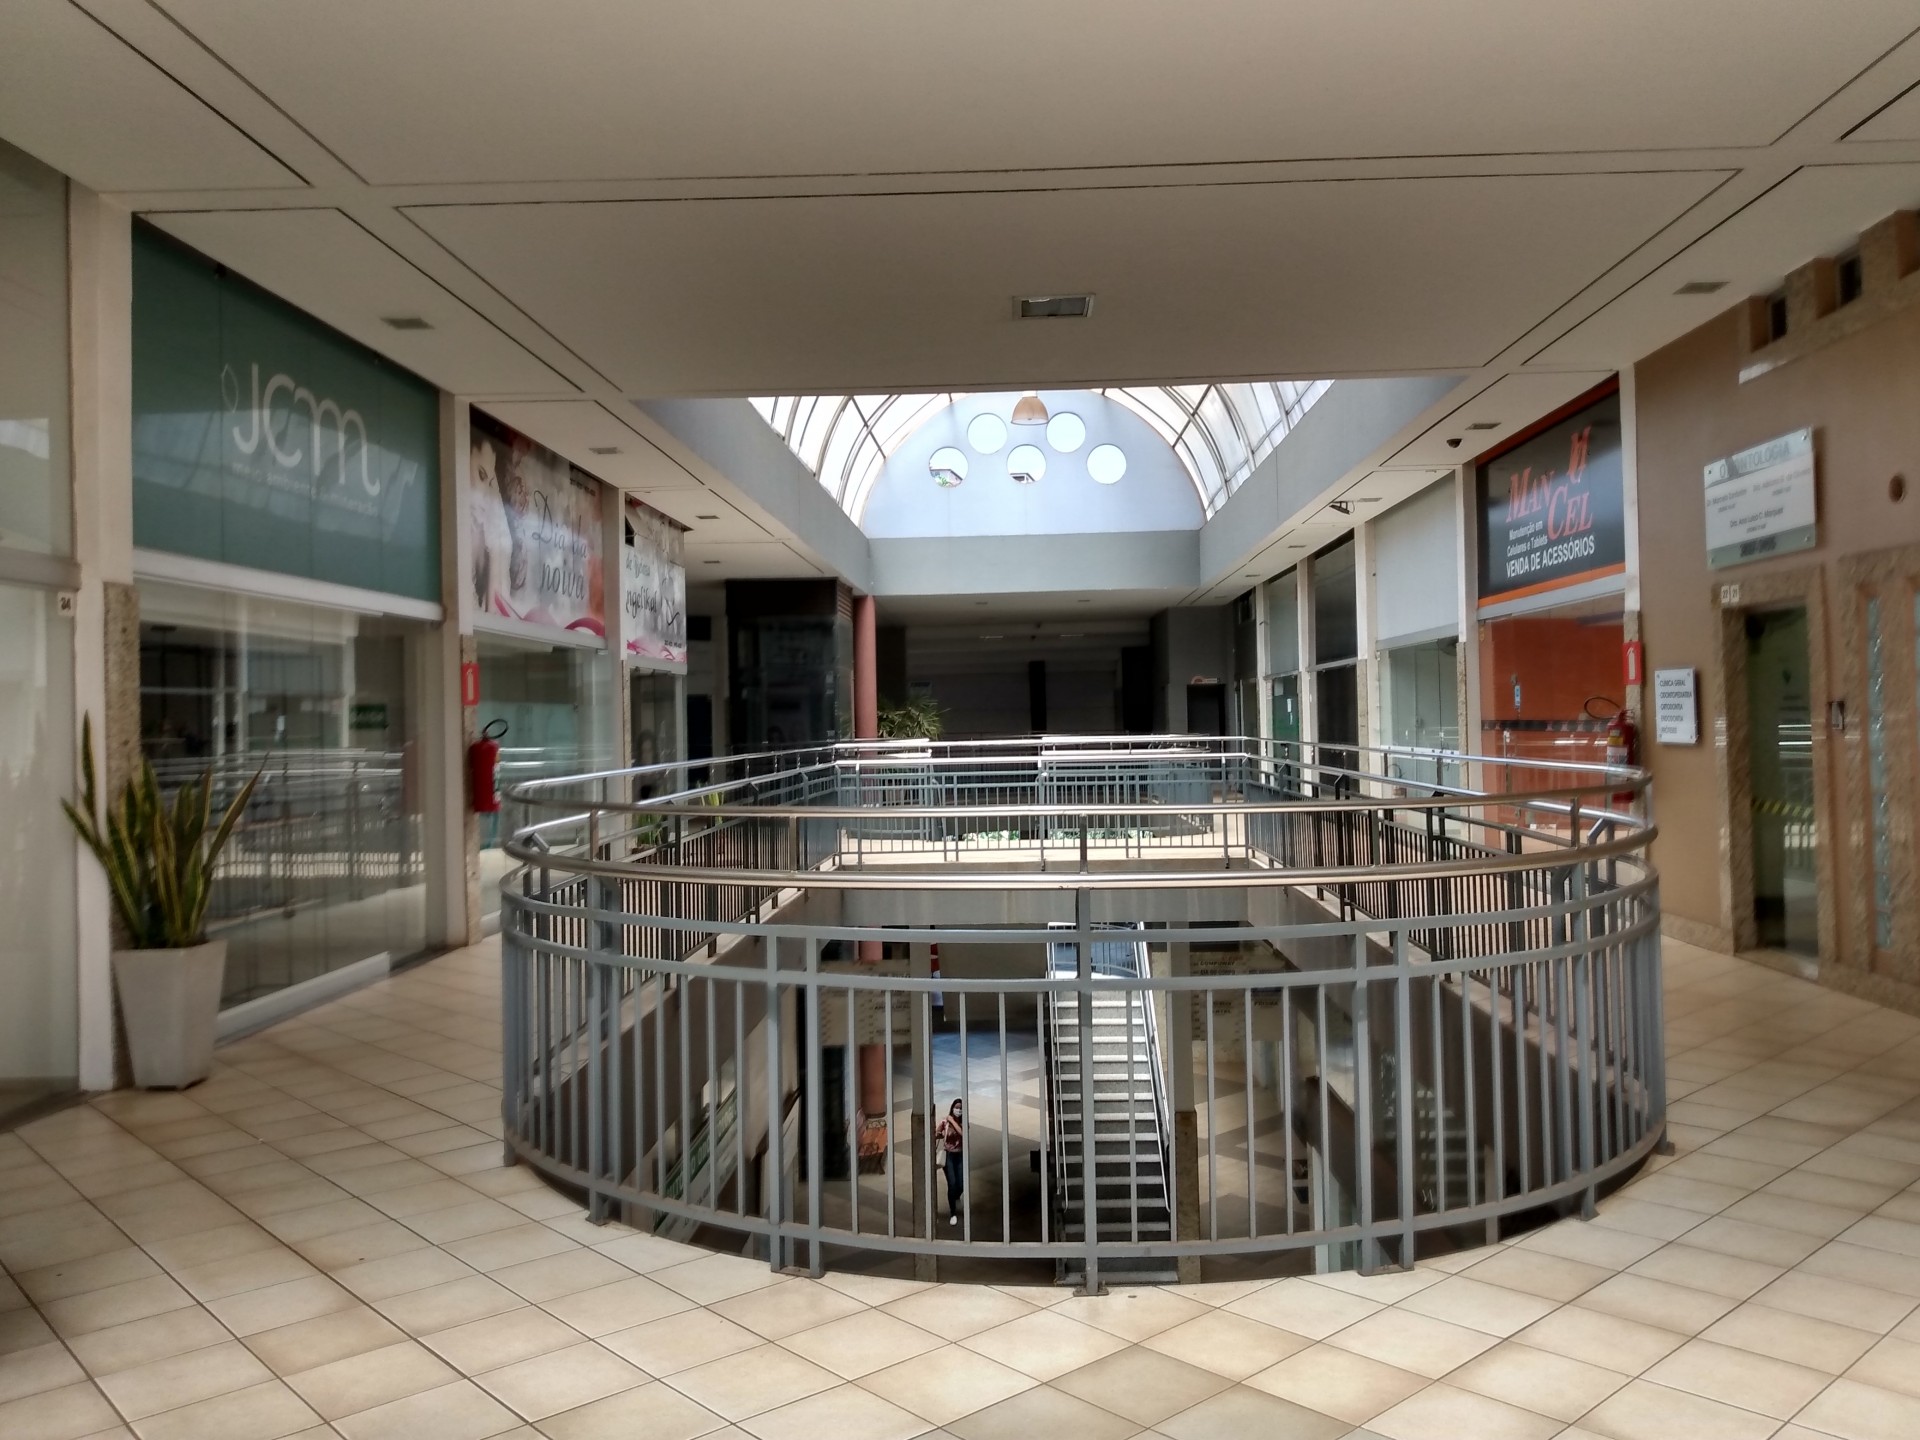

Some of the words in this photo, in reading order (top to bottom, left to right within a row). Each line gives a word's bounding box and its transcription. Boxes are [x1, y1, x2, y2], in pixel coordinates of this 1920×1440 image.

[1506, 556, 1530, 578] VENDA
[1531, 552, 1541, 571] DE
[1542, 535, 1595, 567] ACESSÓRIOS
